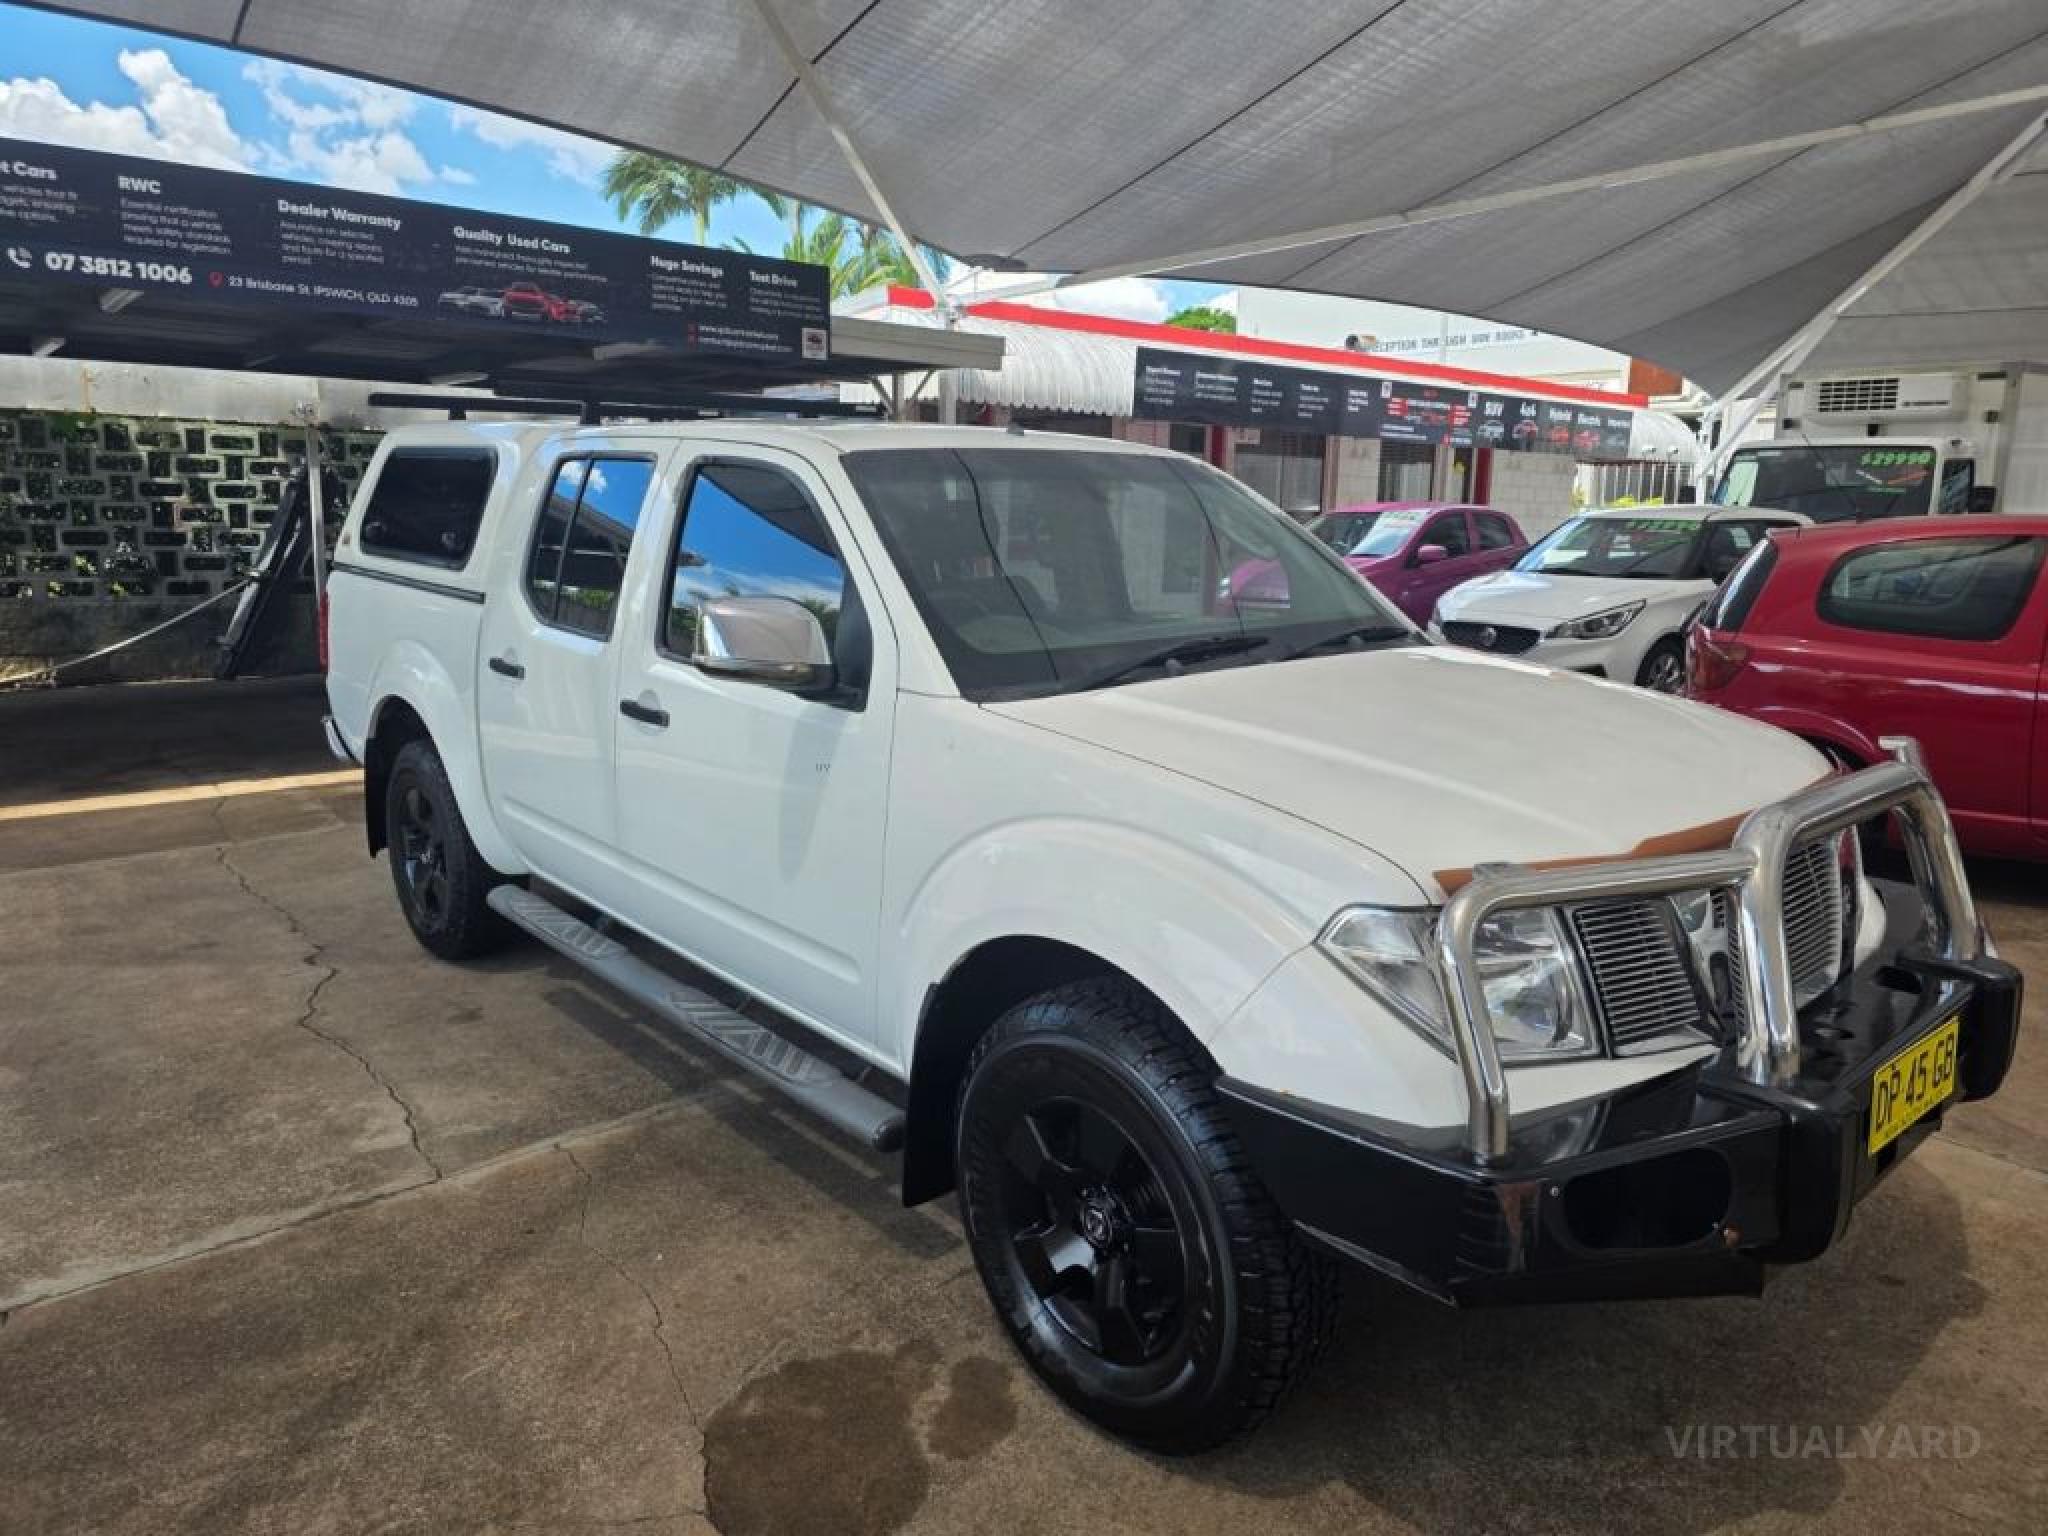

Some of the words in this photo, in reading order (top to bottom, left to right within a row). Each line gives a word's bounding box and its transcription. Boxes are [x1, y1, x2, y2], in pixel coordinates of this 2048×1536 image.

[14, 161, 57, 180] Cars
[118, 175, 161, 194] RWC
[278, 199, 329, 218] Dealer
[331, 207, 402, 231] Warranty
[453, 225, 502, 246] Quality
[507, 233, 539, 249] Used
[541, 239, 571, 254] Cars
[45, 251, 76, 271] 07
[79, 255, 133, 278] 3812
[135, 262, 193, 285] 1006
[650, 255, 681, 272] Huge
[681, 260, 724, 279] Savings
[1905, 1050, 1929, 1104] 45
